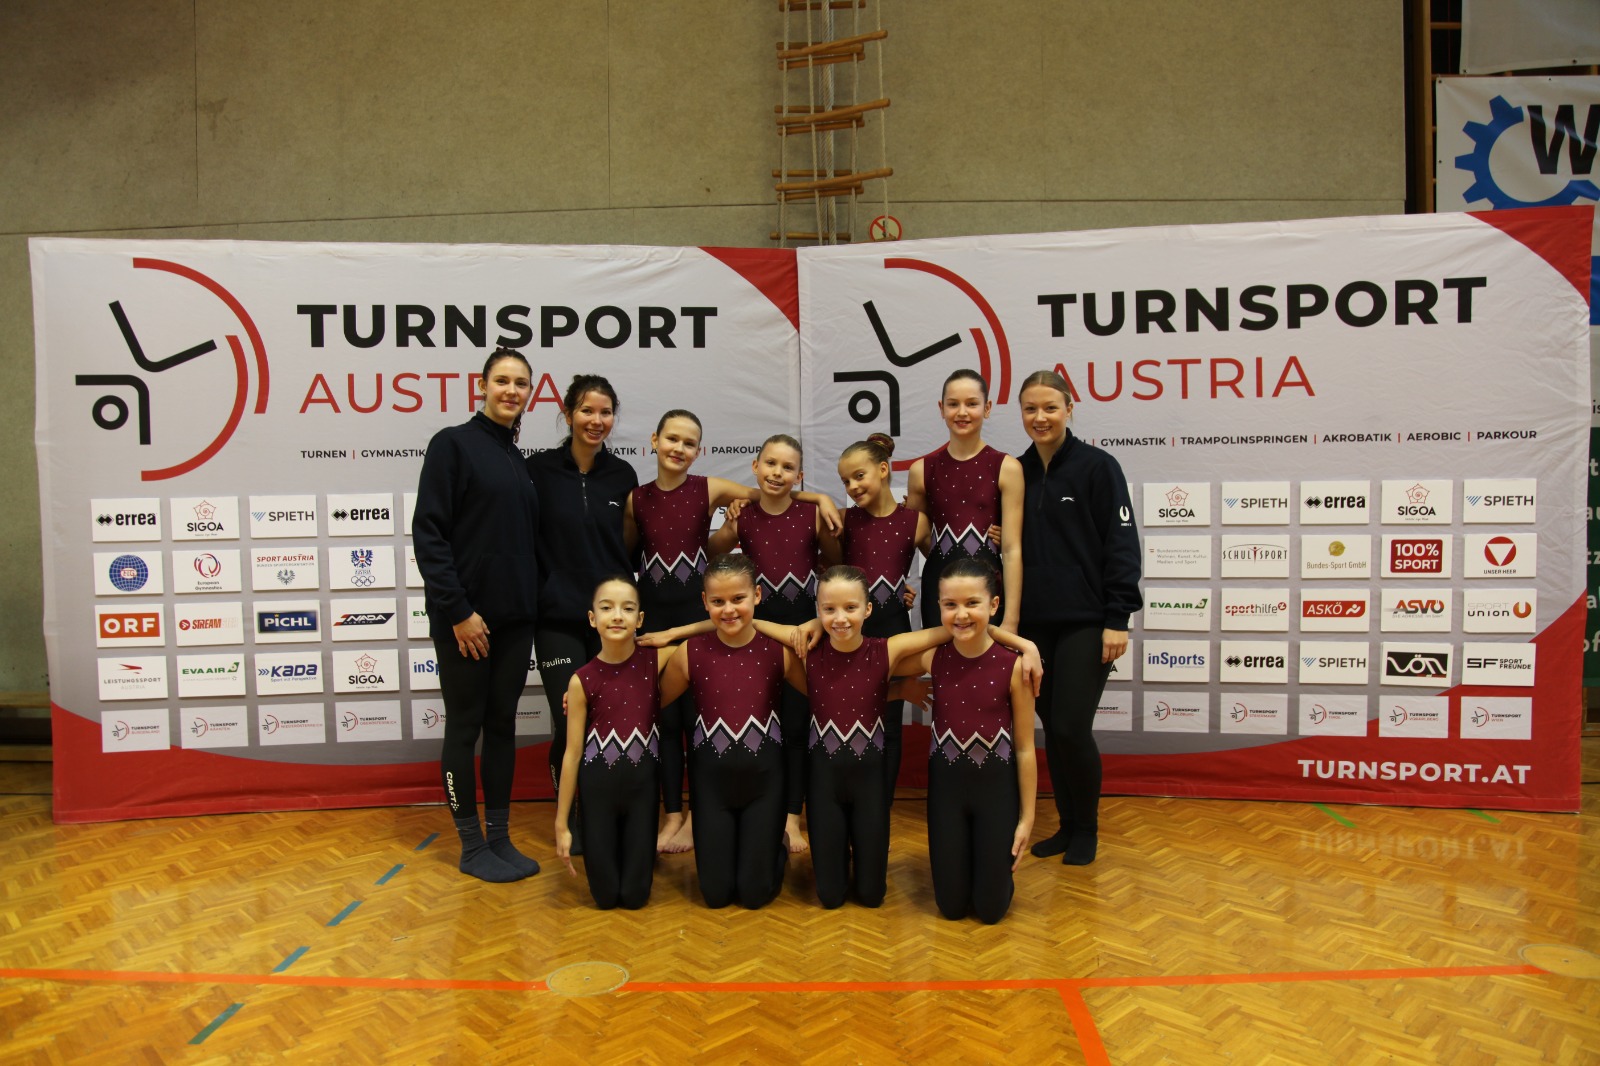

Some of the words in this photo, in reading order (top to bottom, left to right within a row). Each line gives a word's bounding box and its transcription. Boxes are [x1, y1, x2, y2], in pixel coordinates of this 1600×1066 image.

[1038, 276, 1487, 337] TURNSPORT
[297, 304, 718, 349] TURNSPORT
[1100, 437, 1166, 447] GYMNASTIK
[1180, 434, 1308, 445] TRAMPOLINSPRINGEN
[1322, 433, 1392, 443] AKROBATIK
[1406, 432, 1461, 441] AEROBIC
[1476, 430, 1538, 440] PARKOUR
[300, 450, 347, 459] TURNEN
[361, 448, 427, 458] GYMNASTIK
[1240, 498, 1288, 509] SPIETH
[1484, 495, 1534, 506] SPIETH
[268, 511, 315, 522] SPIETH
[1158, 508, 1195, 518] SIGOA
[1397, 506, 1436, 516] SIGOA
[187, 522, 224, 532] SIGOA
[1395, 543, 1439, 556] 100%
[256, 555, 281, 563] SPORT
[282, 553, 314, 562] AUSTRIA
[1348, 560, 1366, 569] GmbH
[1395, 559, 1439, 570] SPORT
[1225, 603, 1278, 617] sporthilfe
[1306, 602, 1343, 615] ASKÖ
[346, 614, 387, 622] NADA
[104, 617, 156, 634] ORF
[192, 618, 222, 630] STREAM
[541, 657, 572, 669] Paulina
[1148, 652, 1205, 668] inSports
[1318, 657, 1366, 668] SPIETH
[1467, 658, 1499, 669] SF
[103, 677, 161, 685] LEISTUNGSSPORT
[348, 674, 385, 685] SIGOA
[1297, 759, 1532, 785] TURNSPORT.AT
[446, 771, 457, 803] CRAFT
